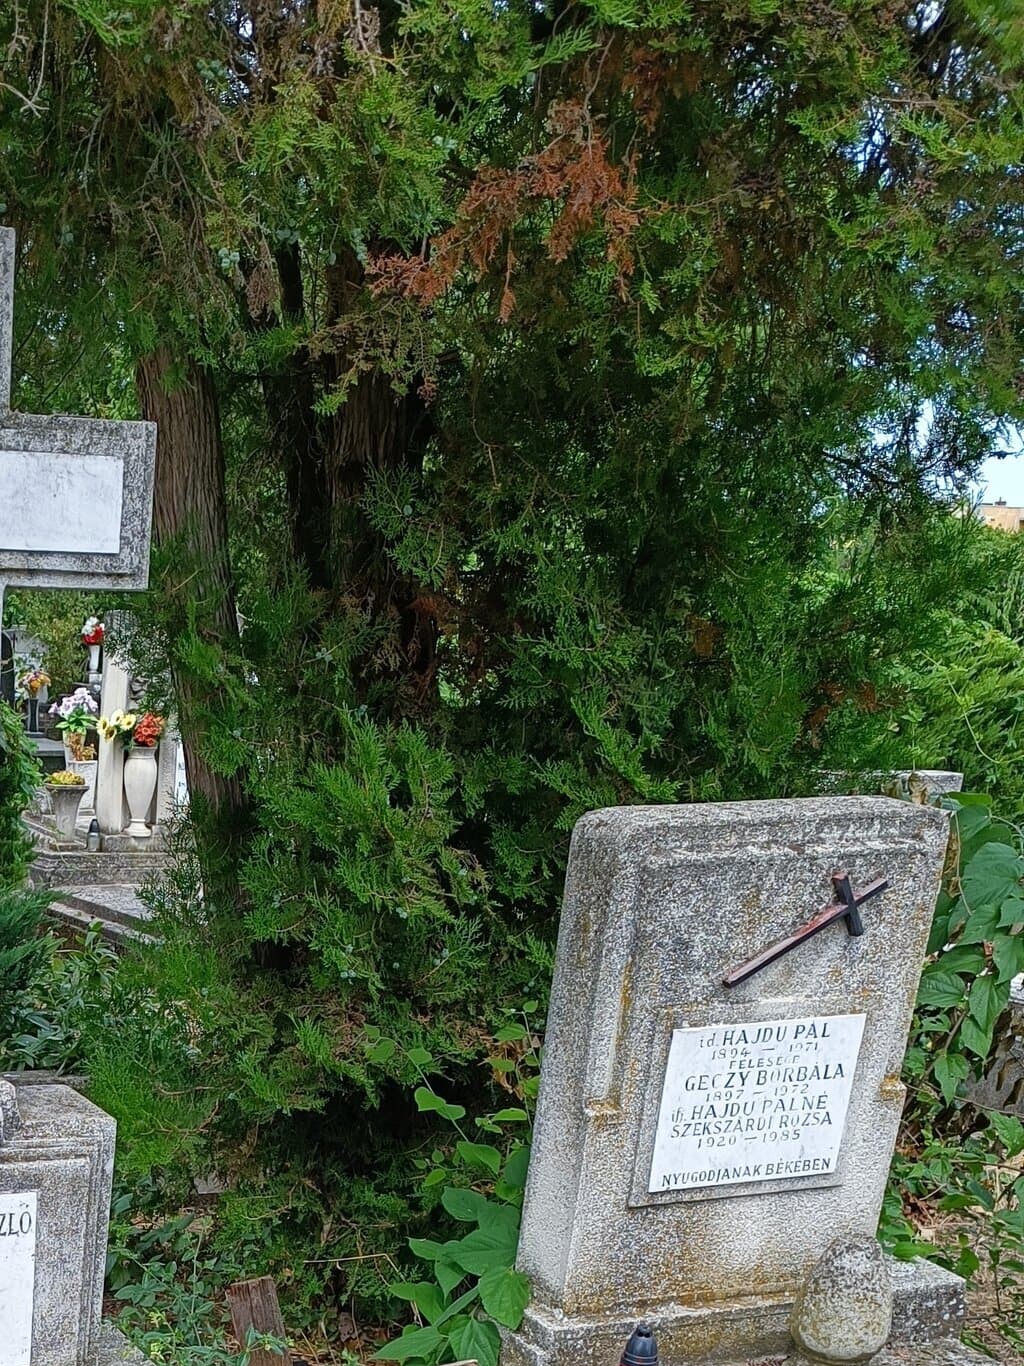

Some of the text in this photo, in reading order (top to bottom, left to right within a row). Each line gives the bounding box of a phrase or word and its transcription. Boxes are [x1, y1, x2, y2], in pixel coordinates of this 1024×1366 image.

[723, 1026, 788, 1046] HAJDU
[706, 1089, 745, 1102] 1897
[774, 1083, 809, 1096] 1972
[691, 1102, 755, 1121] HAJDU
[698, 1135, 737, 1149] 1920
[762, 1129, 801, 1142] 1985
